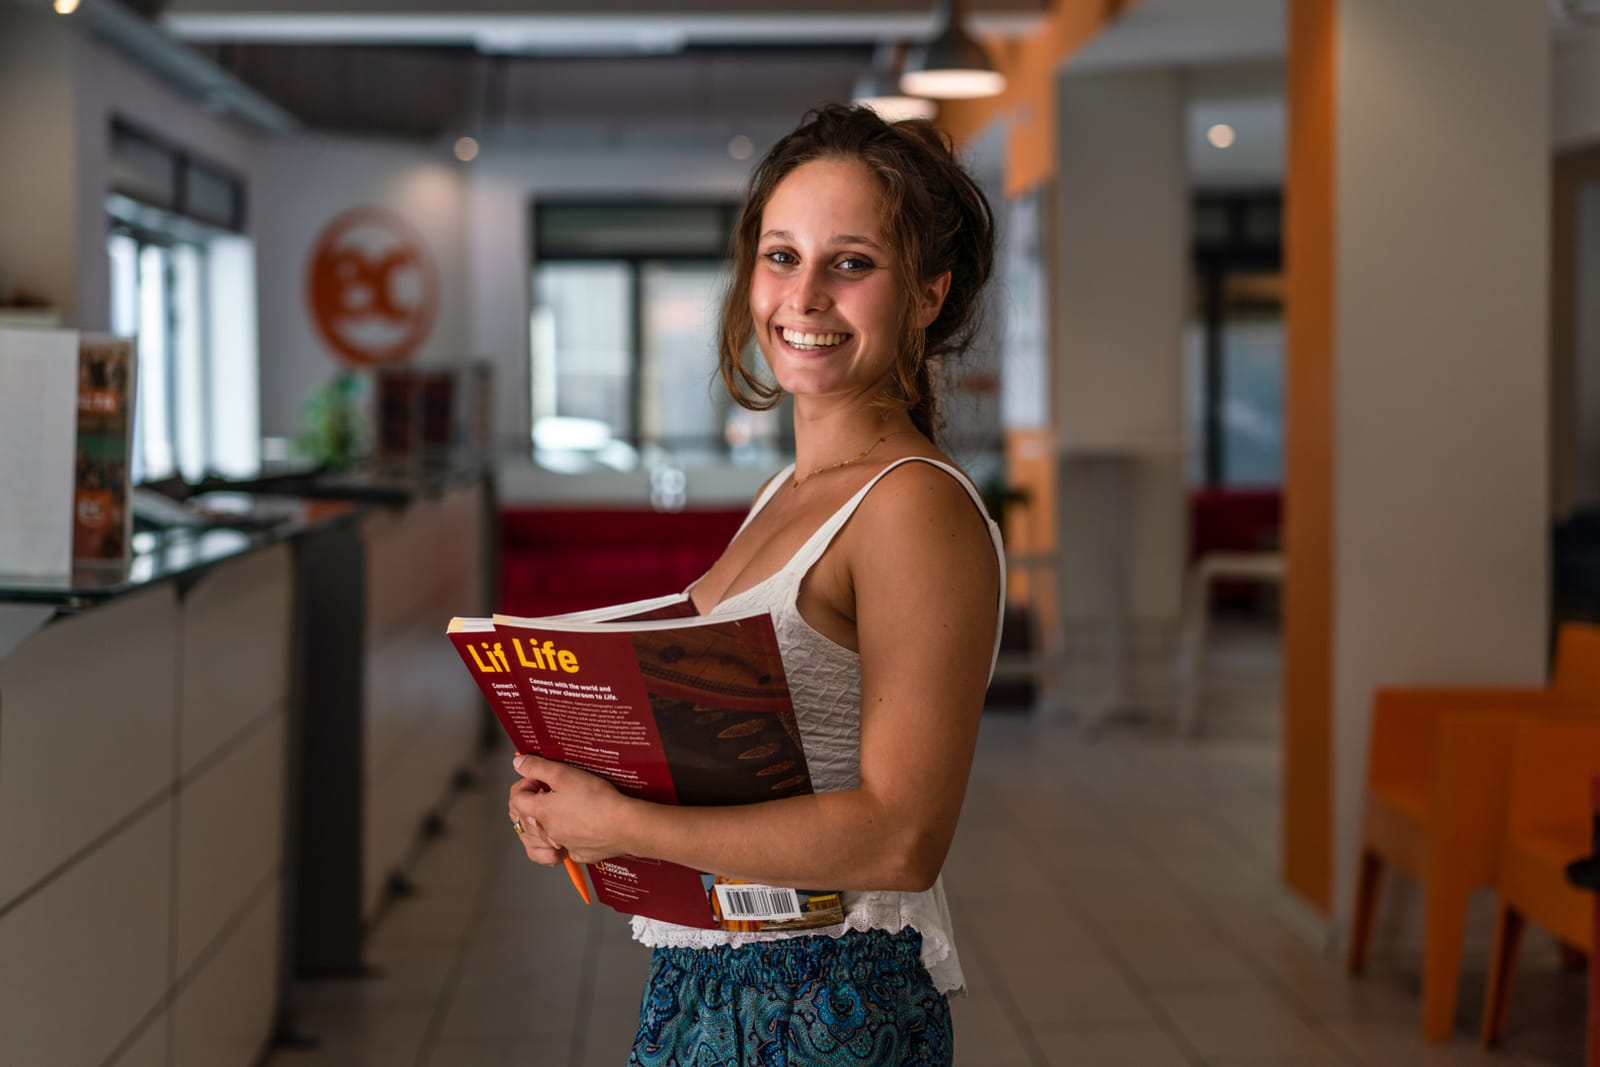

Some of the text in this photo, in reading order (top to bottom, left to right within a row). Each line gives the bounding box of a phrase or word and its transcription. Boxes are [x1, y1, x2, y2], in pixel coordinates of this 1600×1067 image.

[467, 642, 511, 673] Lif
[512, 638, 579, 674] Life
[529, 677, 553, 687] Connect
[554, 681, 568, 689] with
[580, 684, 598, 692] world
[532, 686, 548, 695] bring
[563, 690, 595, 699] classroom
